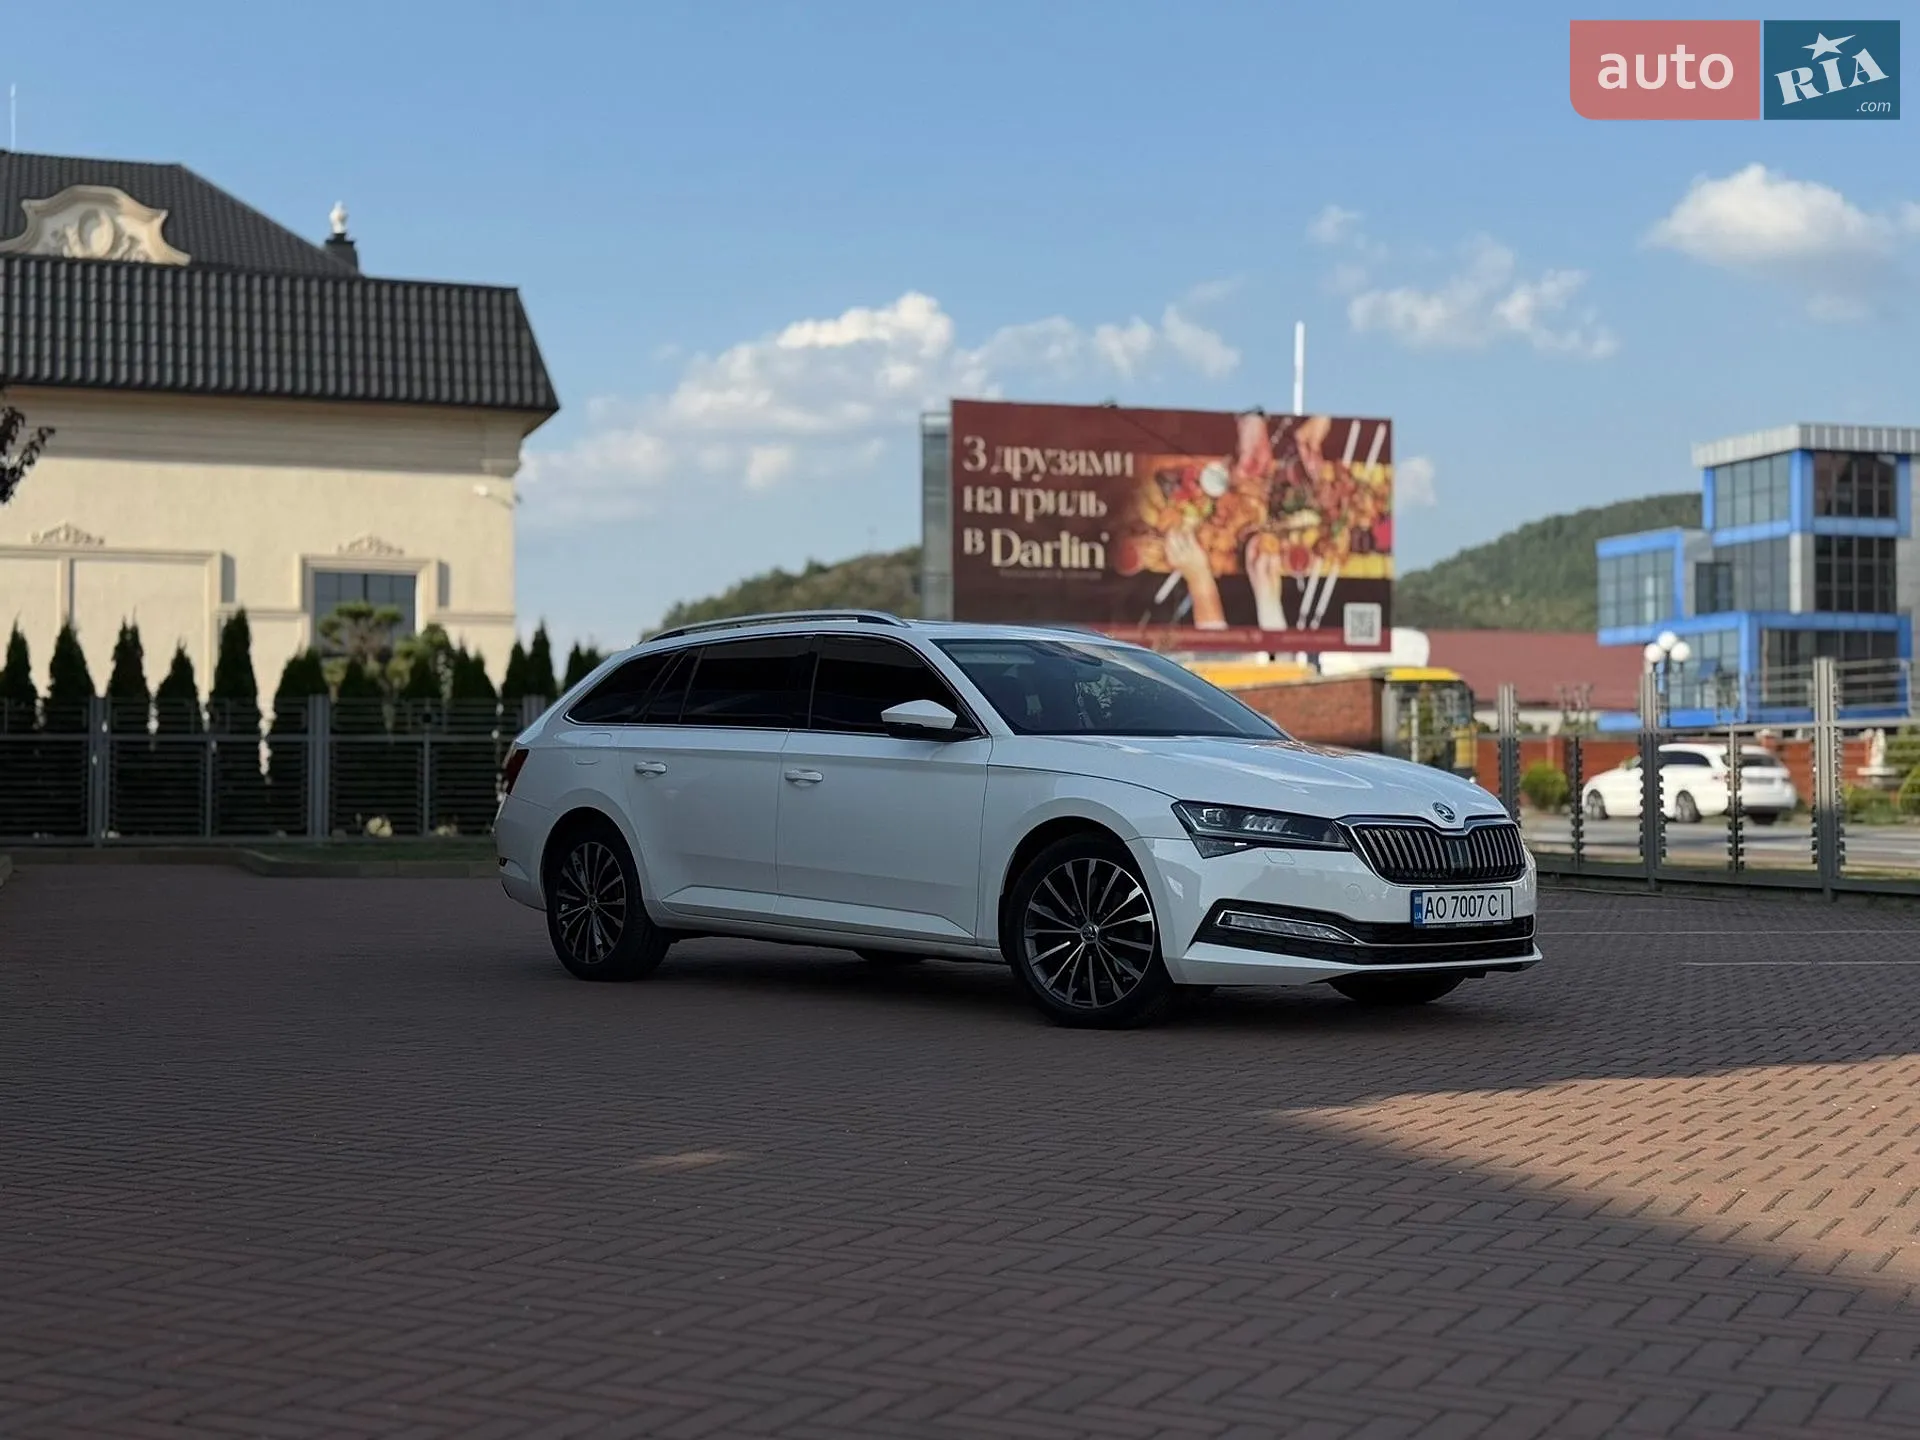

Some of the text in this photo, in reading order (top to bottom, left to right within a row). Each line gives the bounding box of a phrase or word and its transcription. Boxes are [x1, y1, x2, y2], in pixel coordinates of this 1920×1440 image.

[990, 446, 1134, 482] друзями
[963, 486, 1107, 523] на гриль
[1424, 893, 1505, 919] AO 7007 CI
